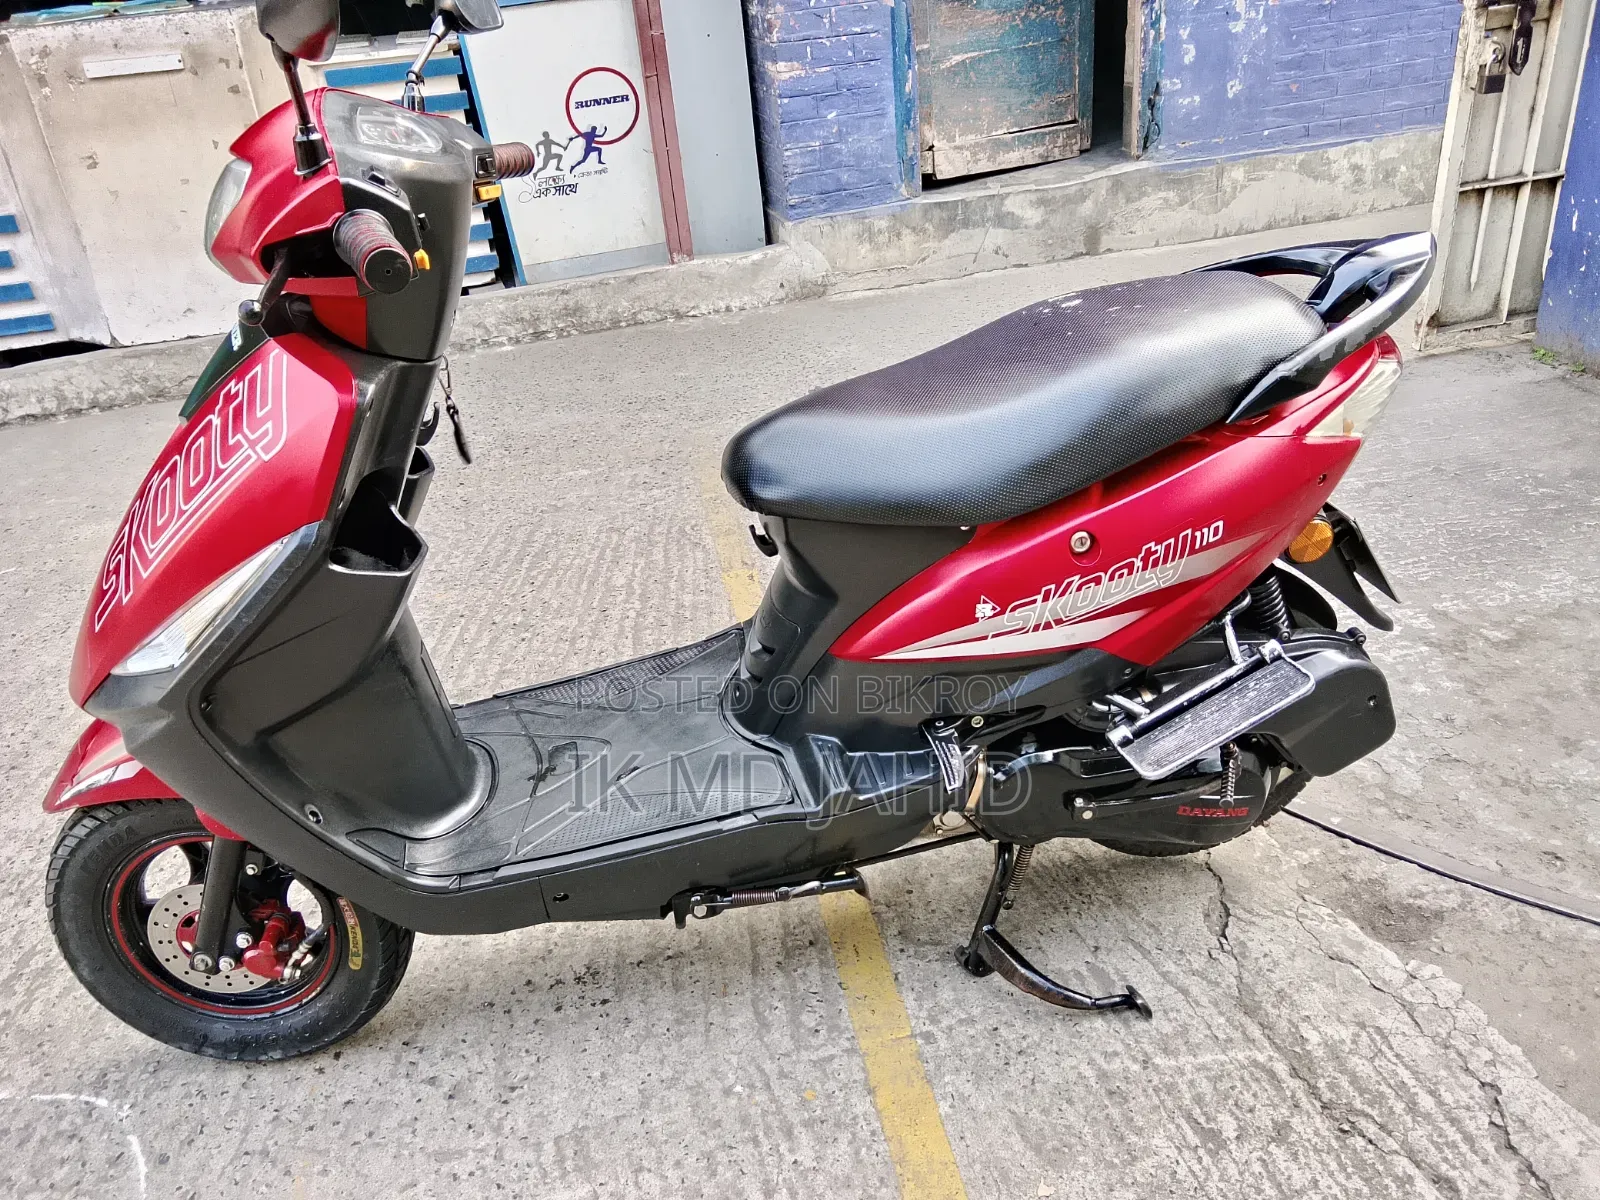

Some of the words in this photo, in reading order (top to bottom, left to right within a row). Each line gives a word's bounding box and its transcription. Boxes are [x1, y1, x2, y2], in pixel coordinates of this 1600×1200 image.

[574, 94, 630, 110] RUNNER
[1194, 520, 1224, 549] 110
[1176, 805, 1249, 818] DAYANG
